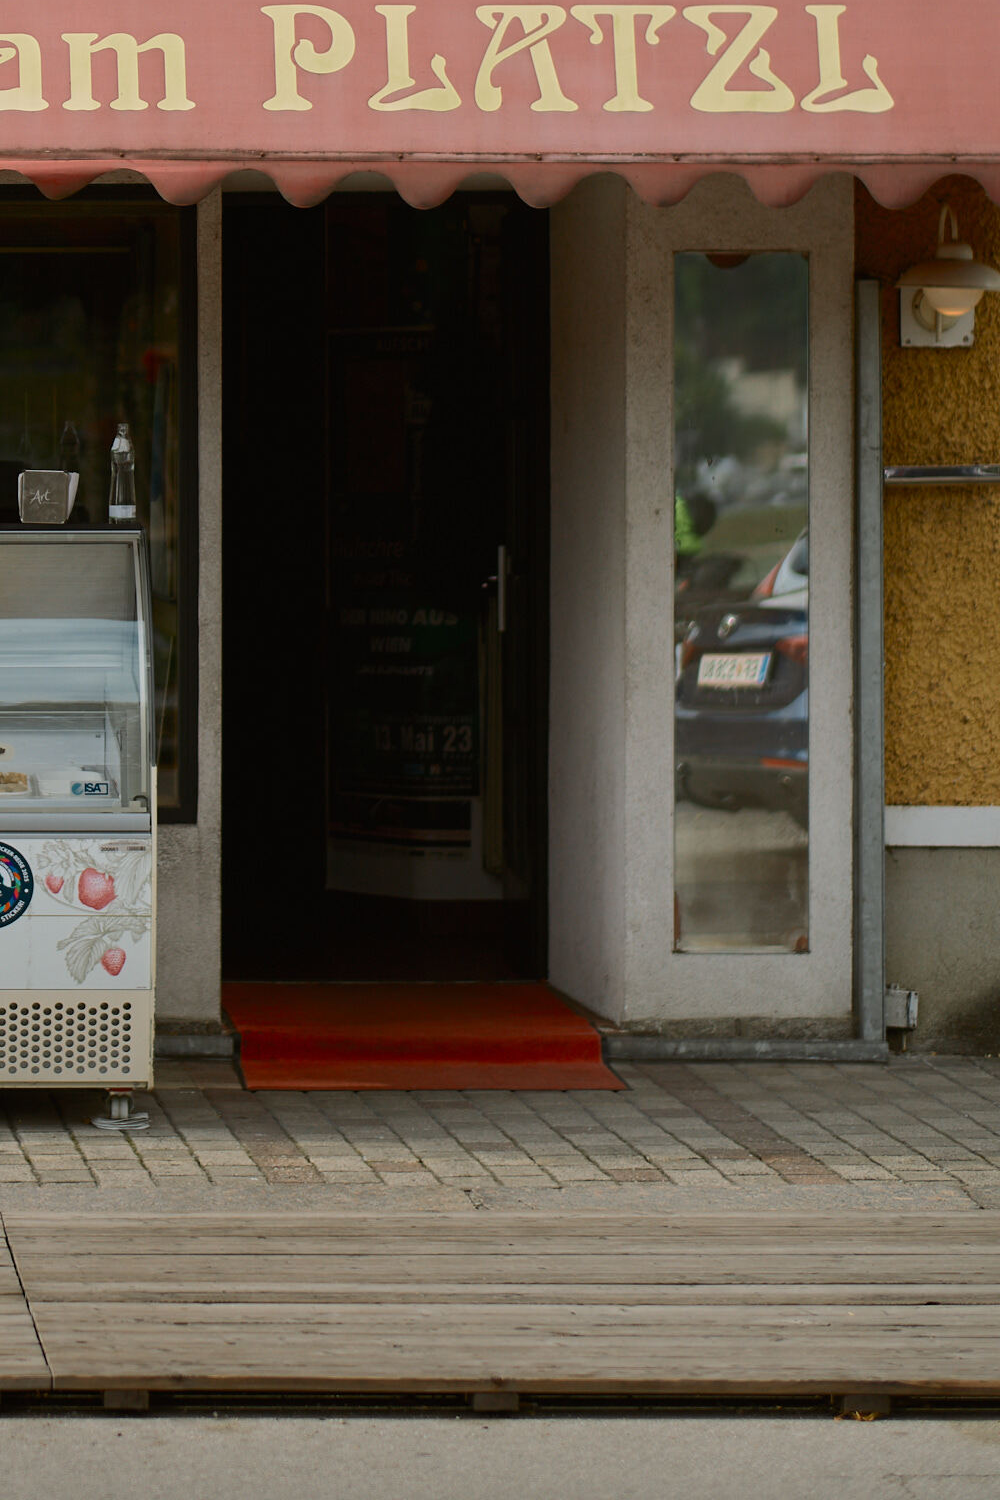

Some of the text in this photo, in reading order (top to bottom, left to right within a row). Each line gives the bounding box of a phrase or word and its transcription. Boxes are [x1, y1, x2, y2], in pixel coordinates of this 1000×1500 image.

[260, 4, 895, 113] PLATZL
[442, 724, 473, 752] 23
[84, 782, 101, 793] ISA
